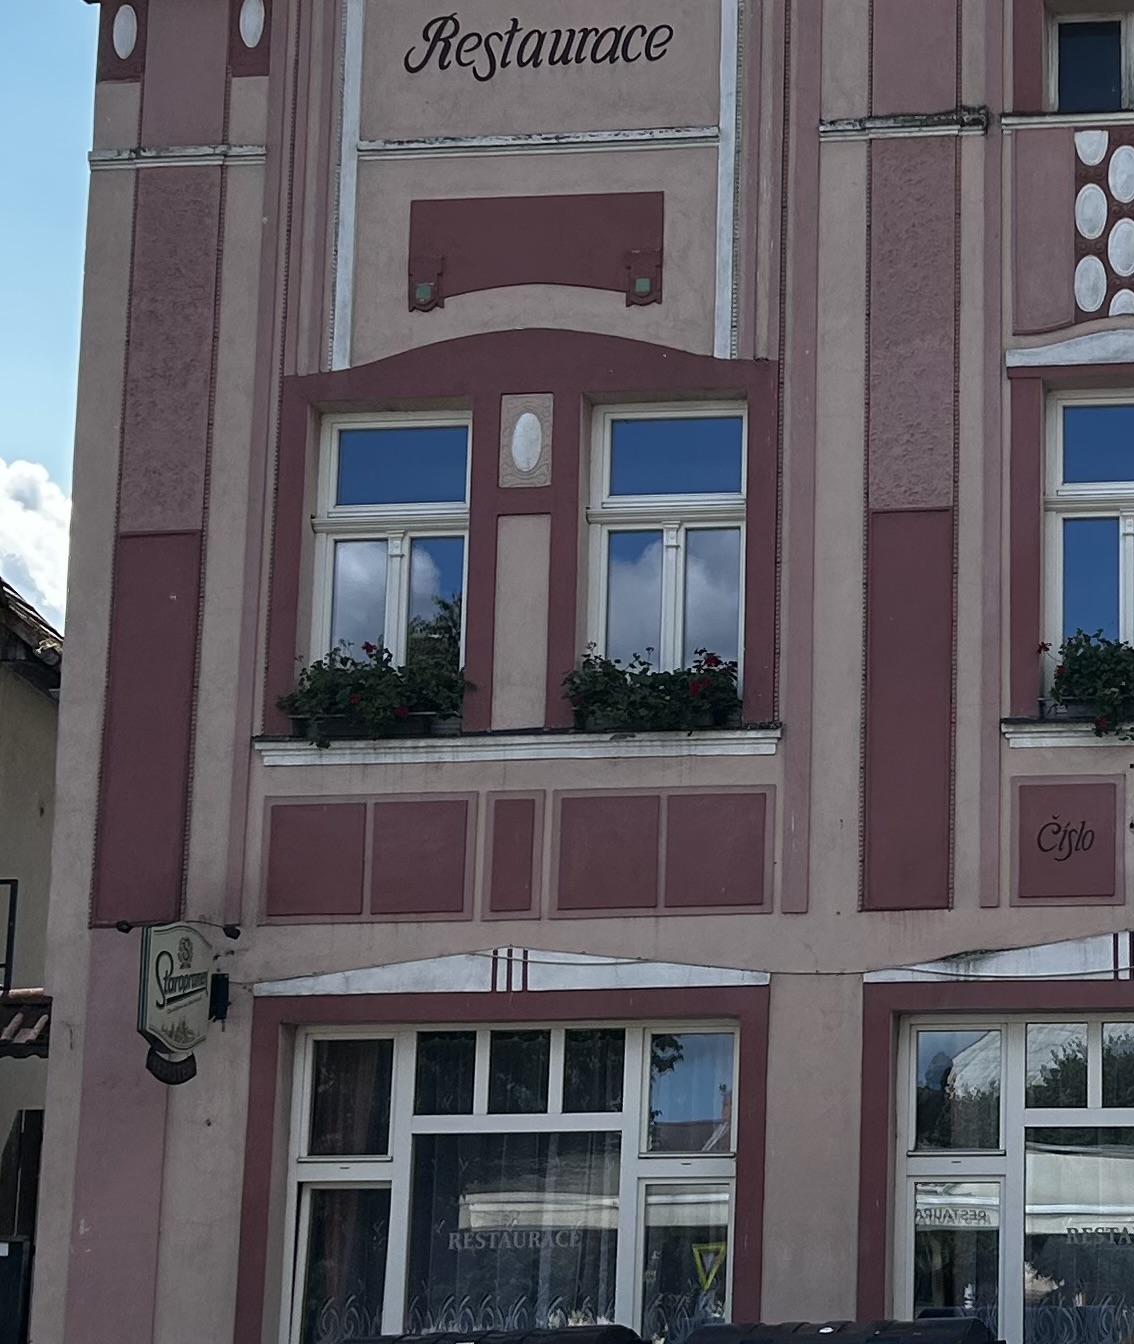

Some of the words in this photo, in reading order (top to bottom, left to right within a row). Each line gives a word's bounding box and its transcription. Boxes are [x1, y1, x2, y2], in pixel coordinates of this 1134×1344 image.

[404, 12, 674, 82] Restaurace
[1037, 815, 1095, 862] Číslo
[448, 1230, 582, 1250] RESTAURACE
